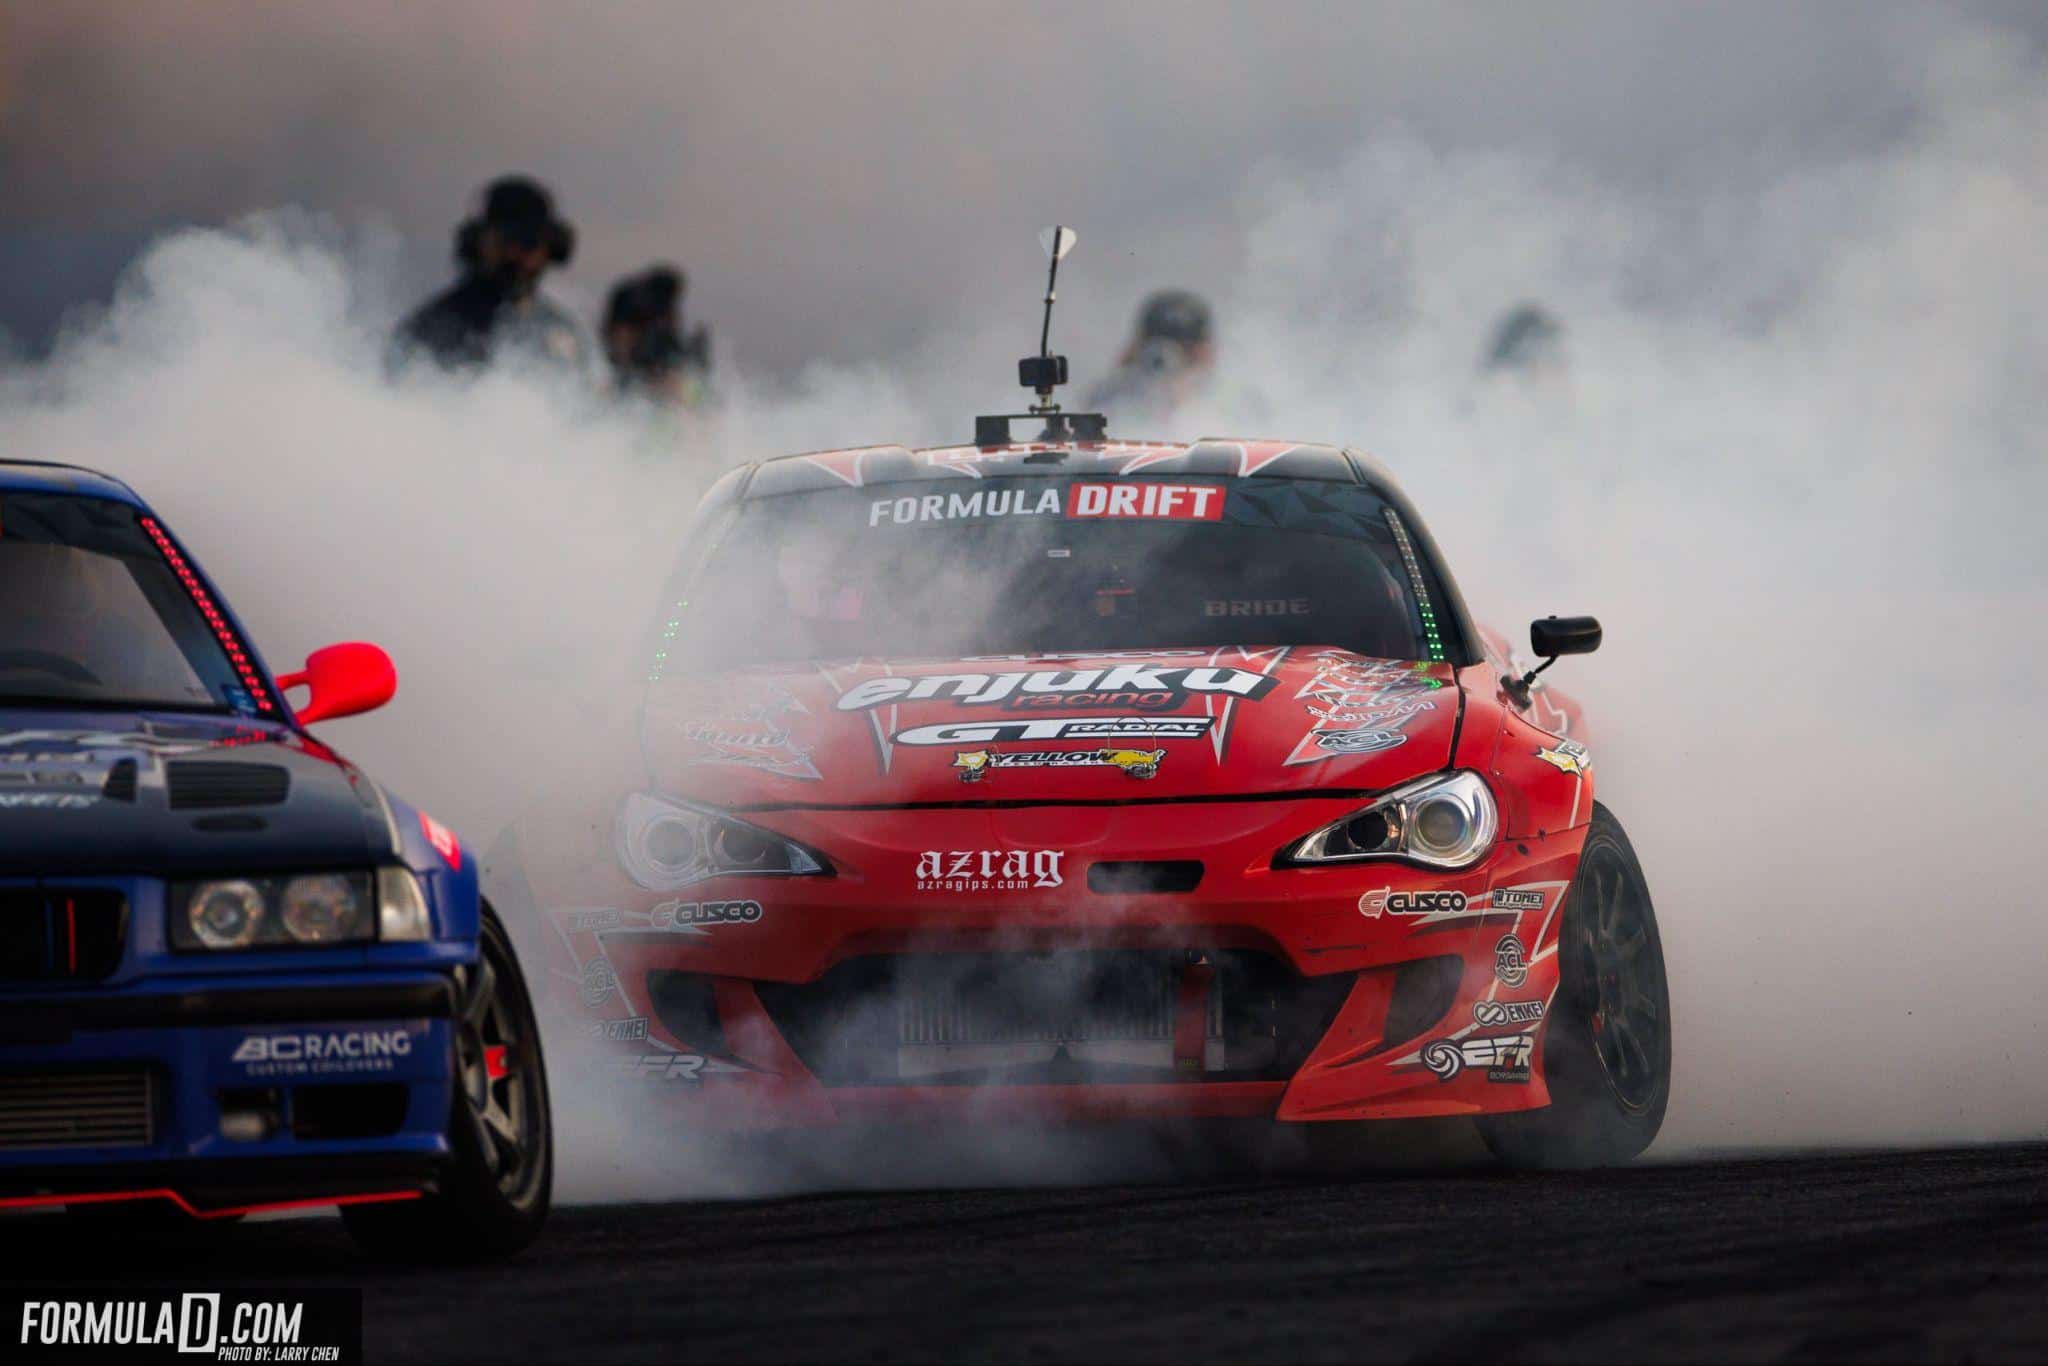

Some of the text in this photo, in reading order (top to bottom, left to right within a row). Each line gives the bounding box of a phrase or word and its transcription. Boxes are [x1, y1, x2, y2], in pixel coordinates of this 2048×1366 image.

[869, 485, 1216, 526] FORMULA DRIFT
[1204, 598, 1311, 616] BRIDE
[837, 664, 1265, 710] enjuku
[1012, 690, 1174, 708] racing
[1069, 722, 1206, 732] RADIAL
[992, 752, 1117, 763] YELLOW
[915, 850, 1064, 887] azrag
[917, 879, 1029, 891] azragips.com
[675, 900, 762, 923] CUSCO
[1386, 891, 1467, 913] CUSCO
[1496, 952, 1526, 969] ACL
[1509, 1002, 1544, 1021] ENKEI
[608, 1020, 646, 1040] ENKEI
[305, 1031, 411, 1058] RACING
